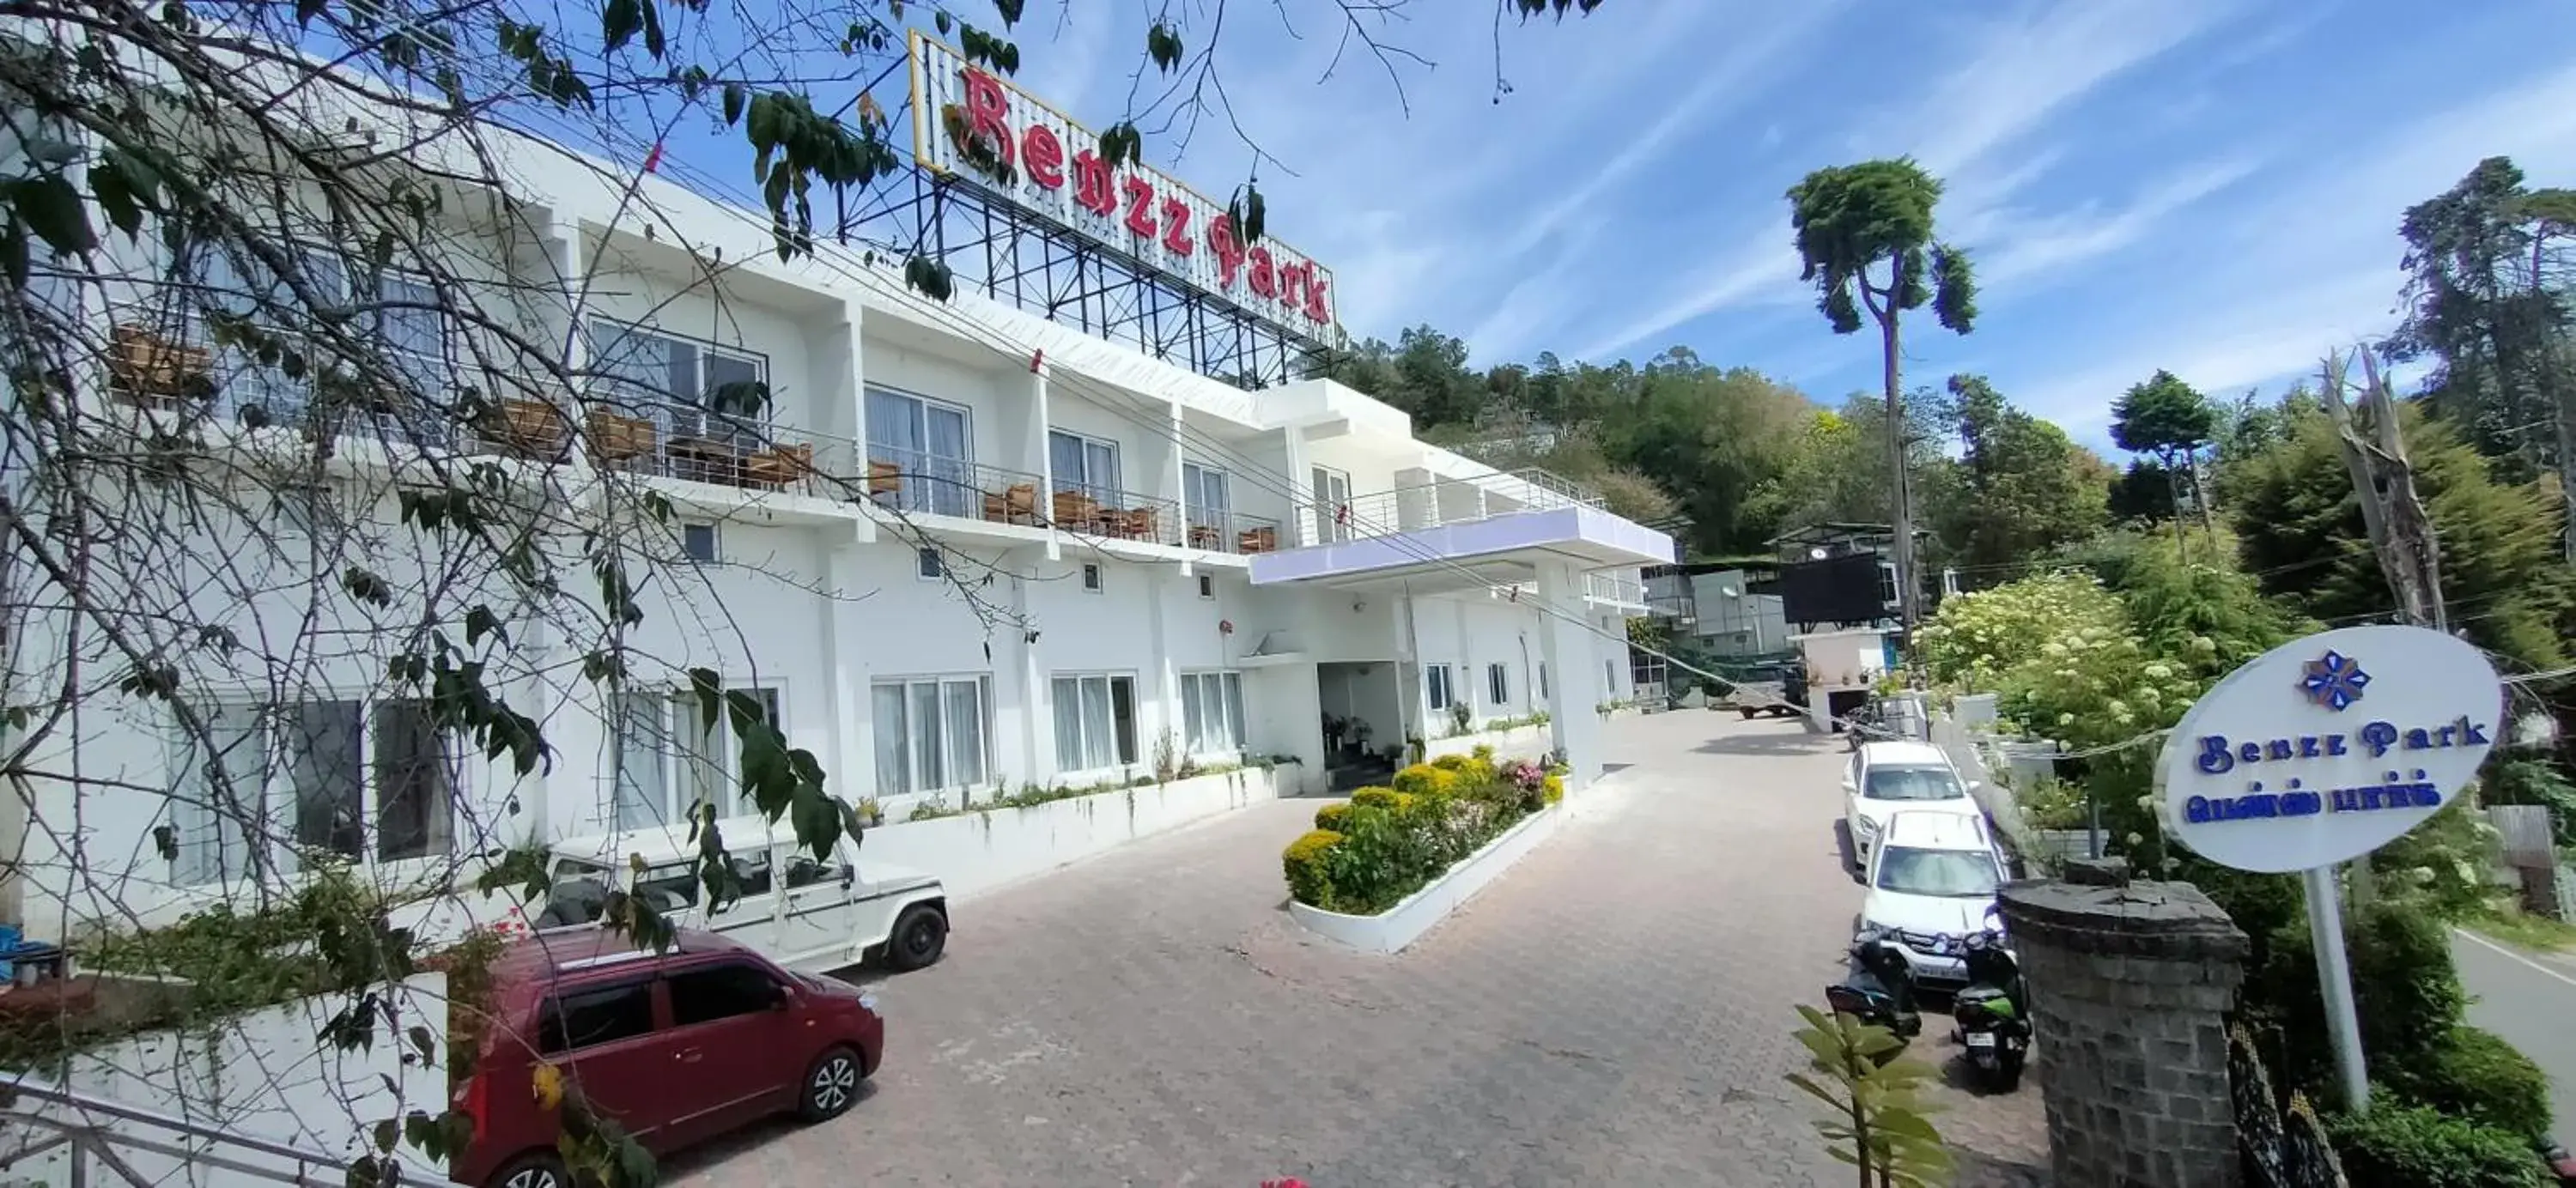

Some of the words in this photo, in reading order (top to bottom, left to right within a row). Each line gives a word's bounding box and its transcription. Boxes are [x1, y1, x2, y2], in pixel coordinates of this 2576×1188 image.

[1207, 214, 1330, 325] Park
[2196, 734, 2348, 774] Benzz
[2360, 713, 2490, 759] Park
[2185, 777, 2322, 824] பென்ஸ்
[2329, 767, 2442, 813] பார்க்
